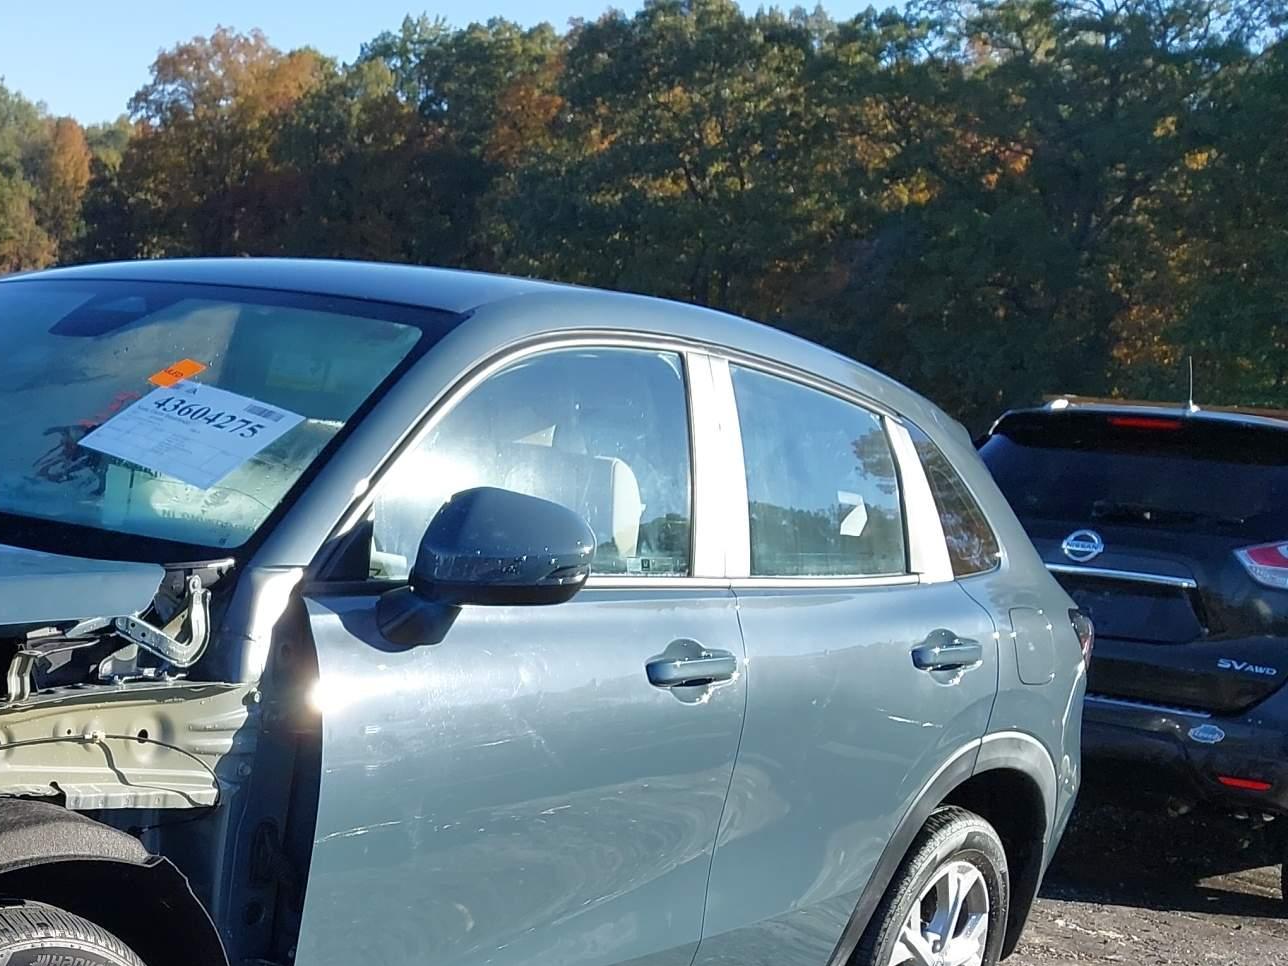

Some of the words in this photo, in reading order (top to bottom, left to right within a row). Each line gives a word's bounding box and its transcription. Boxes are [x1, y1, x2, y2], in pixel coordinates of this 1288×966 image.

[154, 396, 266, 438] 43604275
[1064, 540, 1103, 552] NISSAN
[1217, 658, 1248, 670] SV
[1244, 664, 1277, 676] AWD
